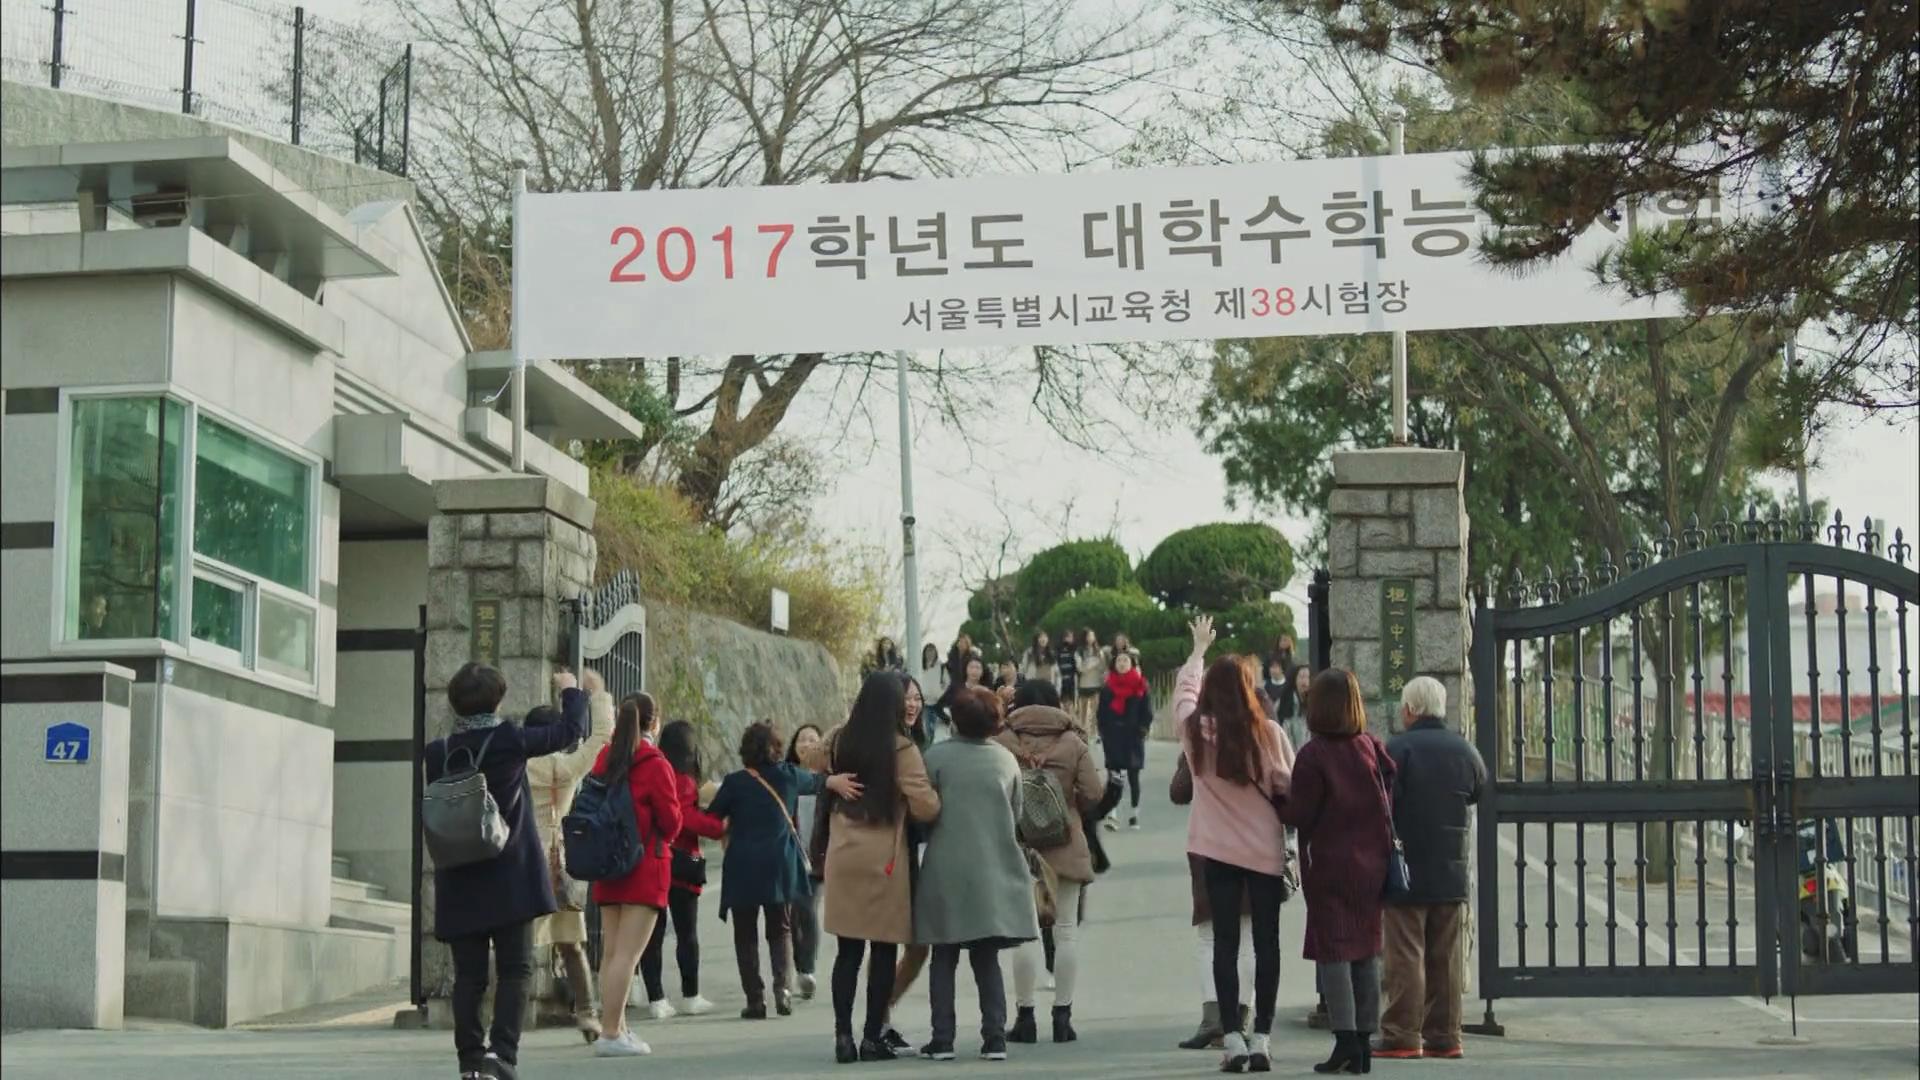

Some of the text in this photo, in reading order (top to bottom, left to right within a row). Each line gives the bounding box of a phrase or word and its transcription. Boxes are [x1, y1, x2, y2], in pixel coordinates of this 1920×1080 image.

[608, 211, 1034, 283] 2017학년도
[901, 279, 1411, 332] 서울특별시교육청 제38시험장
[52, 741, 81, 760] 47
